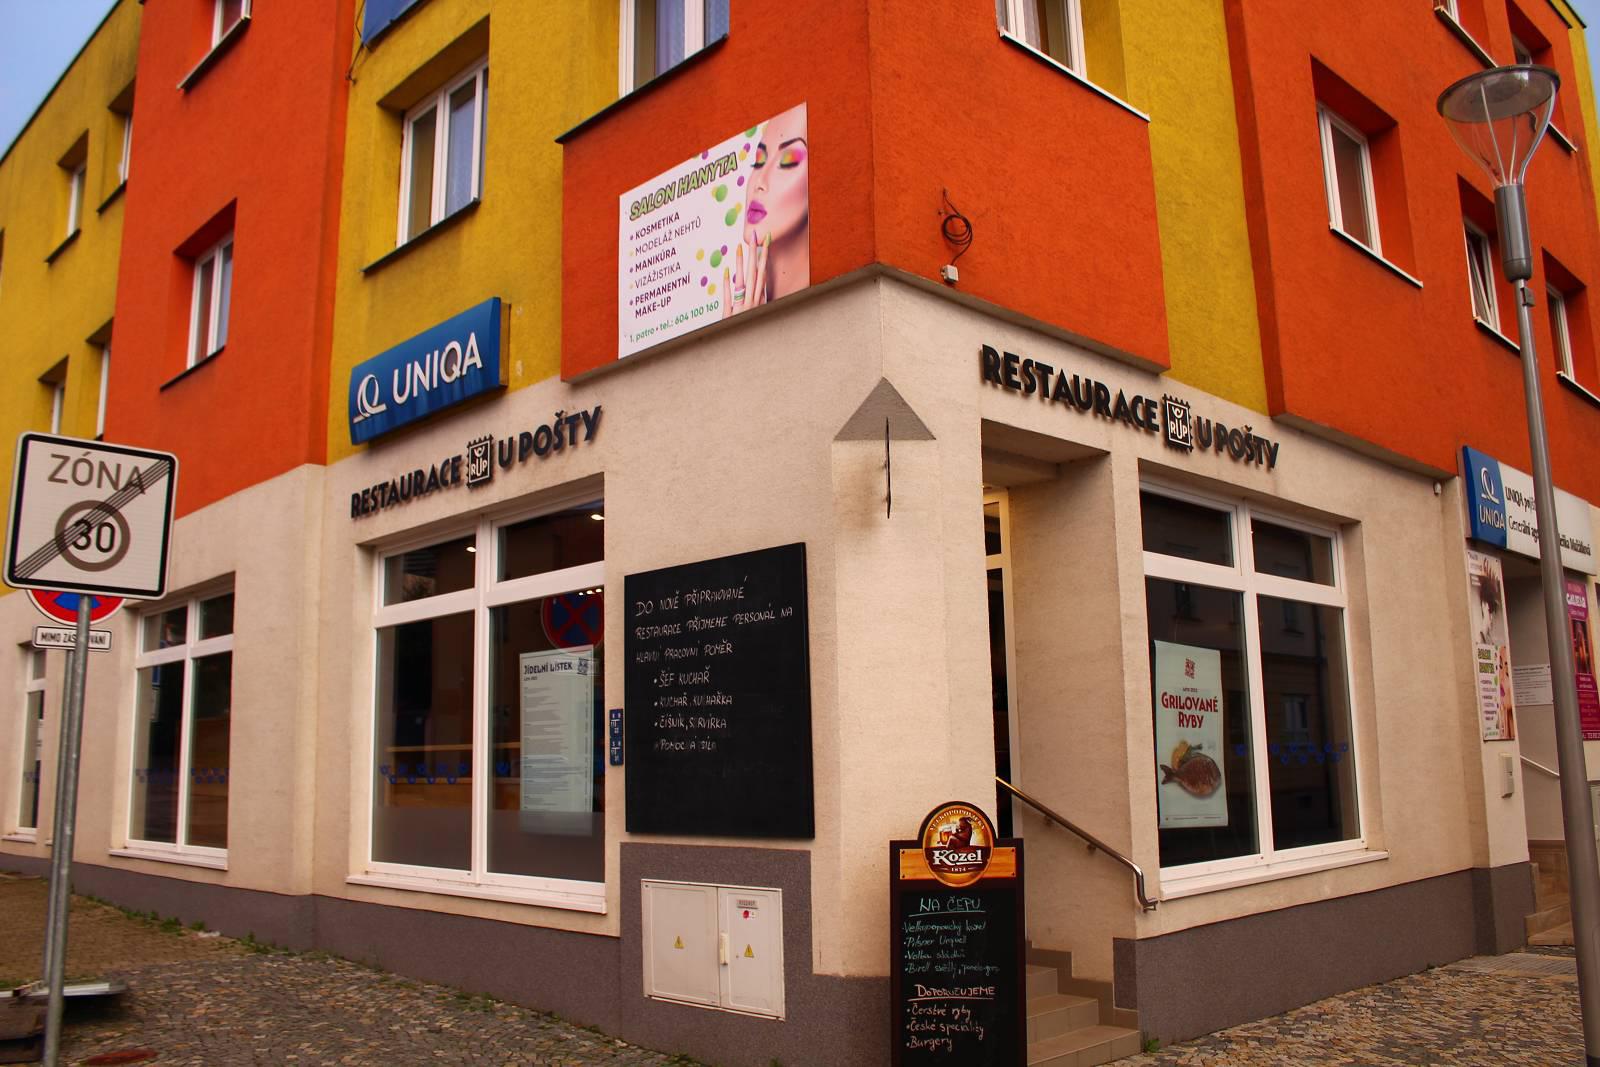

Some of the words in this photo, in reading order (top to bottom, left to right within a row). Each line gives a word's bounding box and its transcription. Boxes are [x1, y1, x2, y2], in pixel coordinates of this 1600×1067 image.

[629, 184, 676, 221] SALON
[677, 152, 738, 199] HANYTA
[635, 211, 680, 240] KOSMETIKA
[635, 229, 672, 257] MODELÁŽ
[674, 216, 702, 240] NEHTŮ
[635, 247, 677, 272] MANIKÚRA
[635, 262, 681, 289] VIZÁŽISTIKA
[635, 272, 691, 306] PERMANENTNÍ
[635, 296, 672, 319] MAKE-UP
[636, 327, 655, 342] patro
[674, 313, 689, 326] 604
[690, 306, 704, 320] 100
[706, 300, 719, 313] 160
[392, 332, 483, 405] UNIQA
[981, 344, 1160, 433] RESTAURACE
[1195, 415, 1212, 449] U
[1215, 424, 1280, 470] POŠTY
[47, 451, 146, 495] ZÓNA
[350, 455, 462, 519] RESTAURACE
[497, 437, 514, 468] U
[518, 405, 602, 462] POŠTY
[1479, 504, 1505, 531] UNIQA
[71, 519, 115, 553] 30
[635, 600, 654, 617] DO
[635, 622, 681, 640] RESTAURACE
[733, 602, 775, 625] PERSONÁL
[780, 606, 793, 618] NA
[41, 631, 61, 643] MIMO
[63, 630, 107, 646] ZÁSVÁNÍ
[524, 661, 549, 675] JÍDELNÍ
[1161, 692, 1219, 713] GRILOVANÉ
[1178, 711, 1204, 729] RYBY
[932, 849, 983, 866] Kozel
[919, 897, 940, 912] NA
[946, 896, 981, 912] ČEPU
[912, 1002, 947, 1016] Čerstvé
[909, 1036, 953, 1053] Burgery
